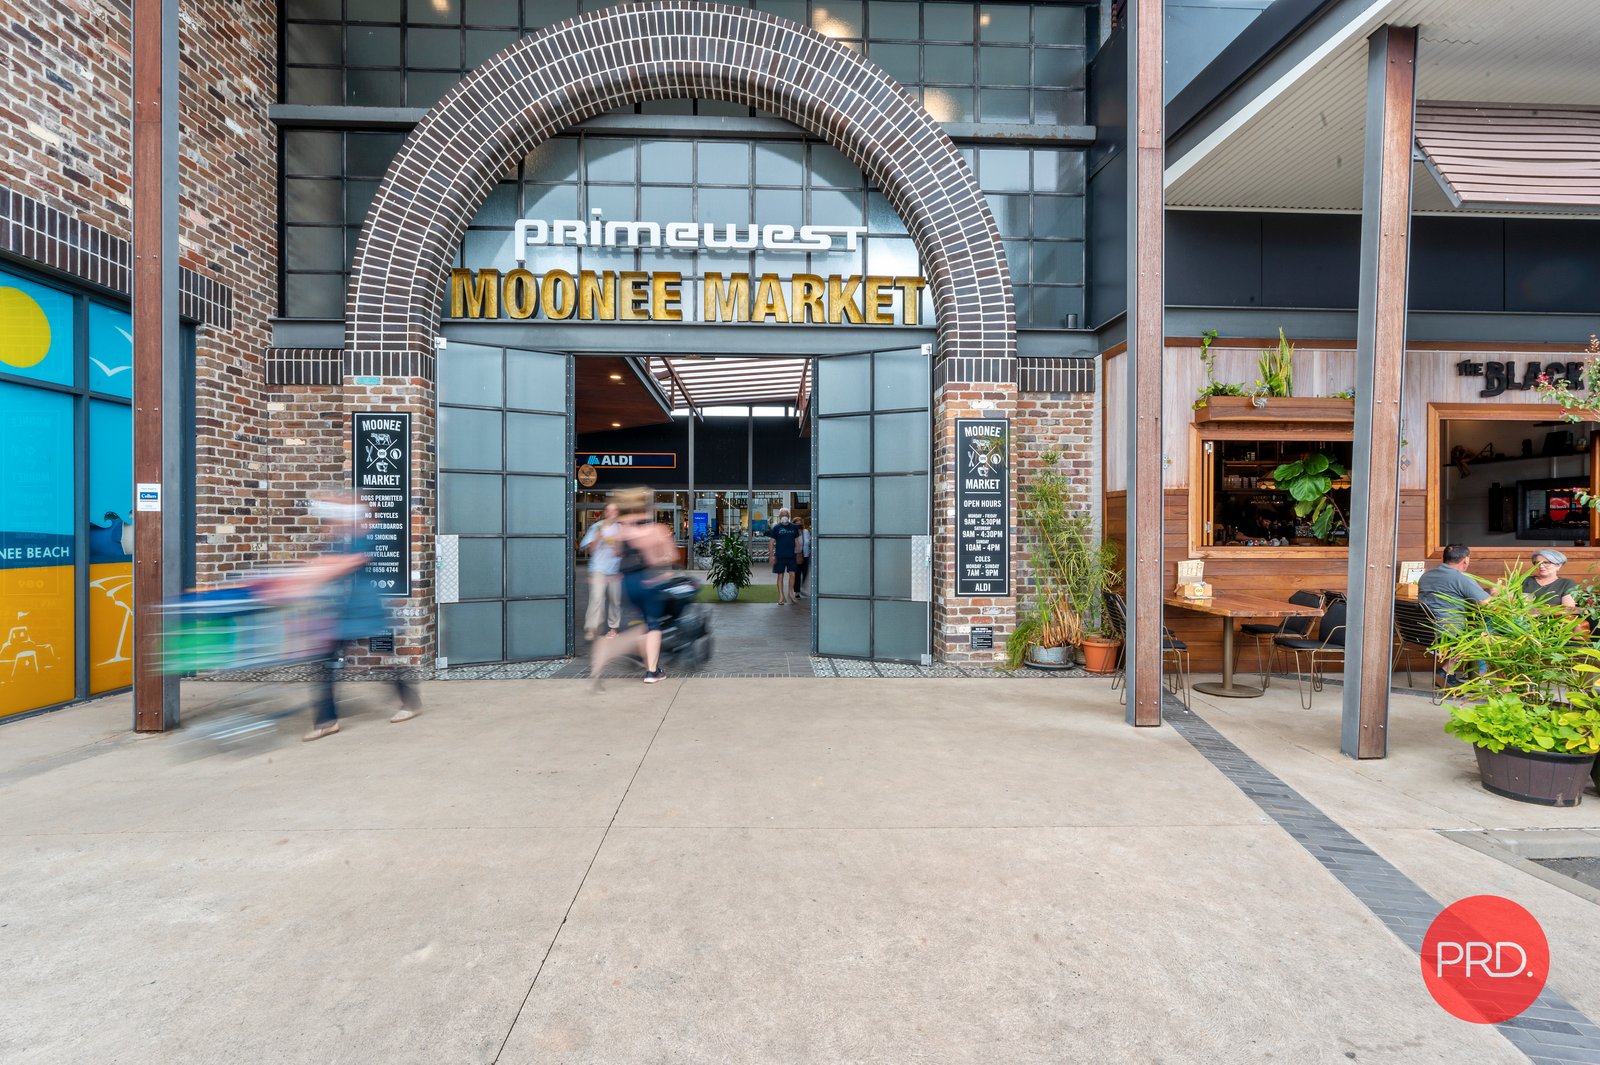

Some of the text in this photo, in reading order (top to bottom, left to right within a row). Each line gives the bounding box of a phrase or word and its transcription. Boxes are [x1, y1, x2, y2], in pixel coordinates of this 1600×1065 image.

[451, 268, 926, 325] MOONEE MARKET
[1456, 358, 1484, 377] THE
[362, 419, 402, 431] MOONEE
[964, 425, 1001, 437] MOONEE
[601, 455, 633, 466] ALDI
[363, 474, 401, 486] MARKET
[965, 479, 1000, 489] MARKET
[964, 500, 1002, 508] OPEN HOURS
[27, 546, 70, 558] BEACH
[975, 583, 991, 591] ALDI
